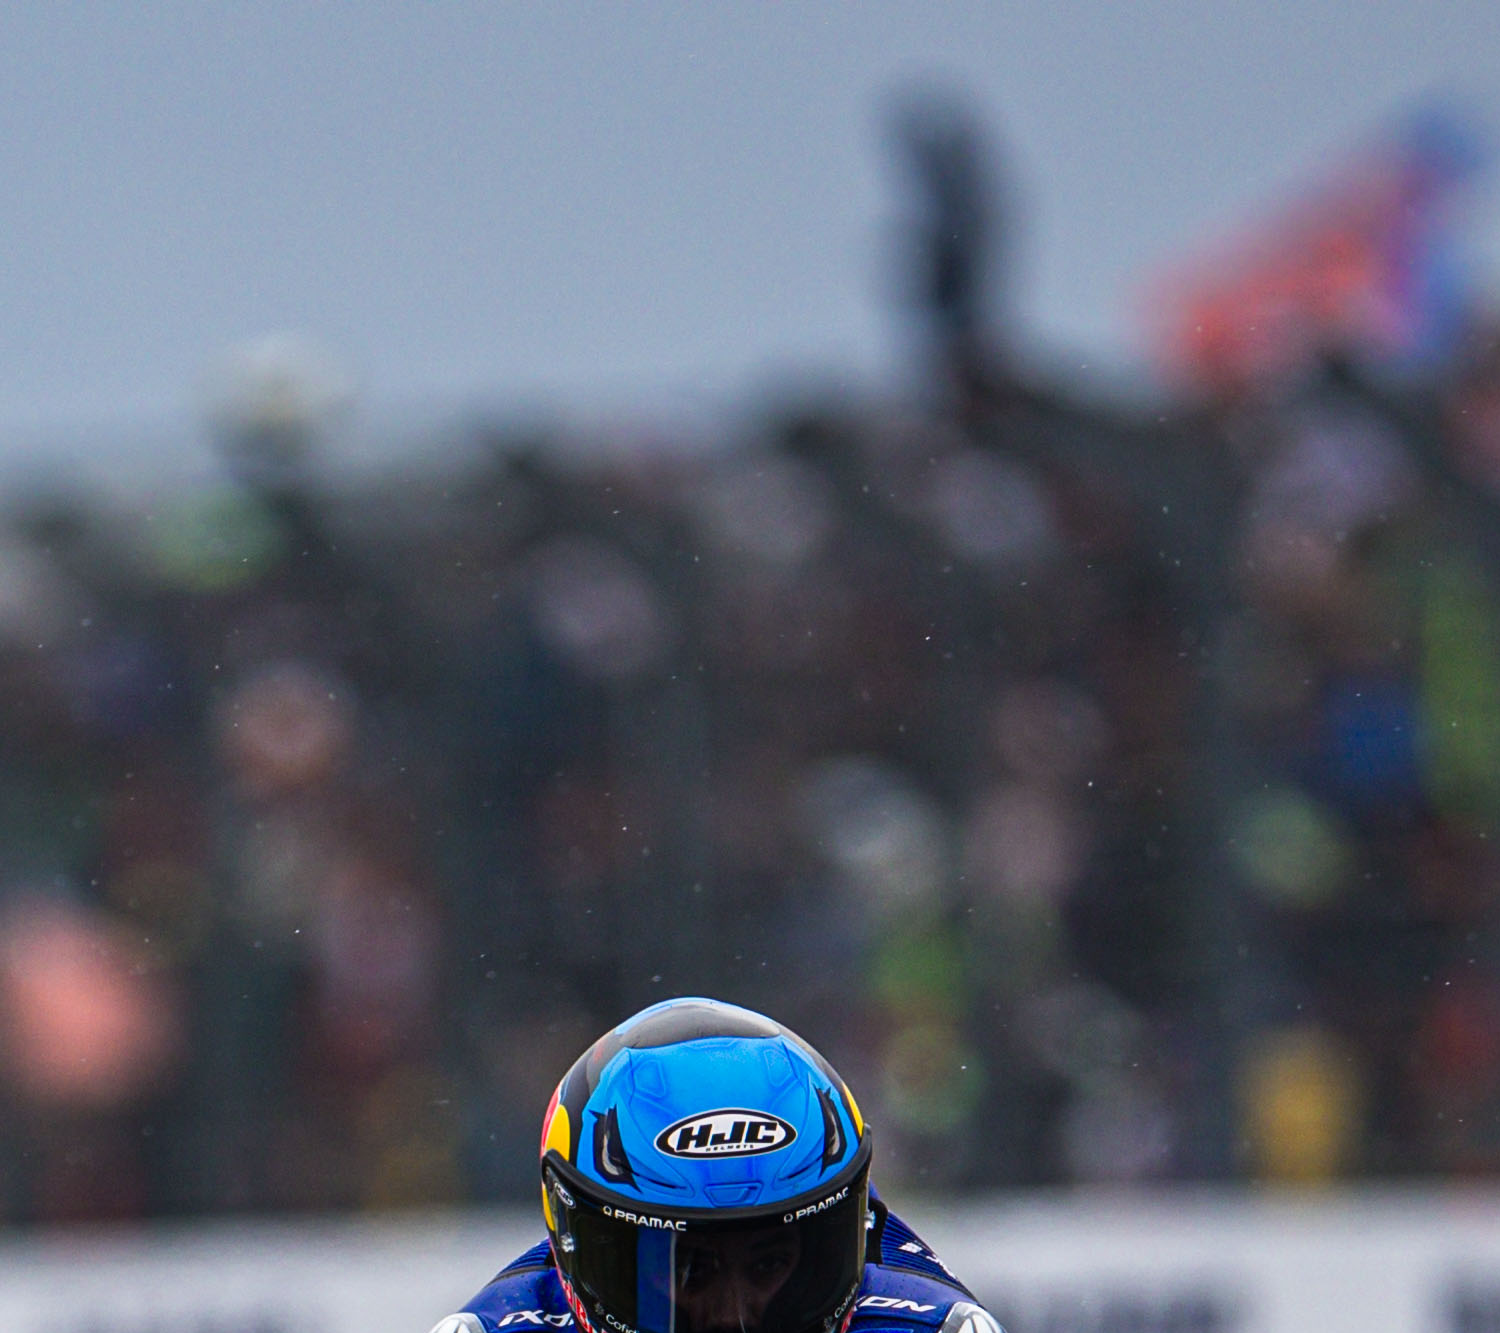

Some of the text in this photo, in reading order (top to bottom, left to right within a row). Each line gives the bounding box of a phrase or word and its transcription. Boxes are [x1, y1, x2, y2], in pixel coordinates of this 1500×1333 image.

[675, 1120, 778, 1151] HJC
[796, 1187, 849, 1220] PRAMAC
[615, 1209, 687, 1231] PRAMAC
